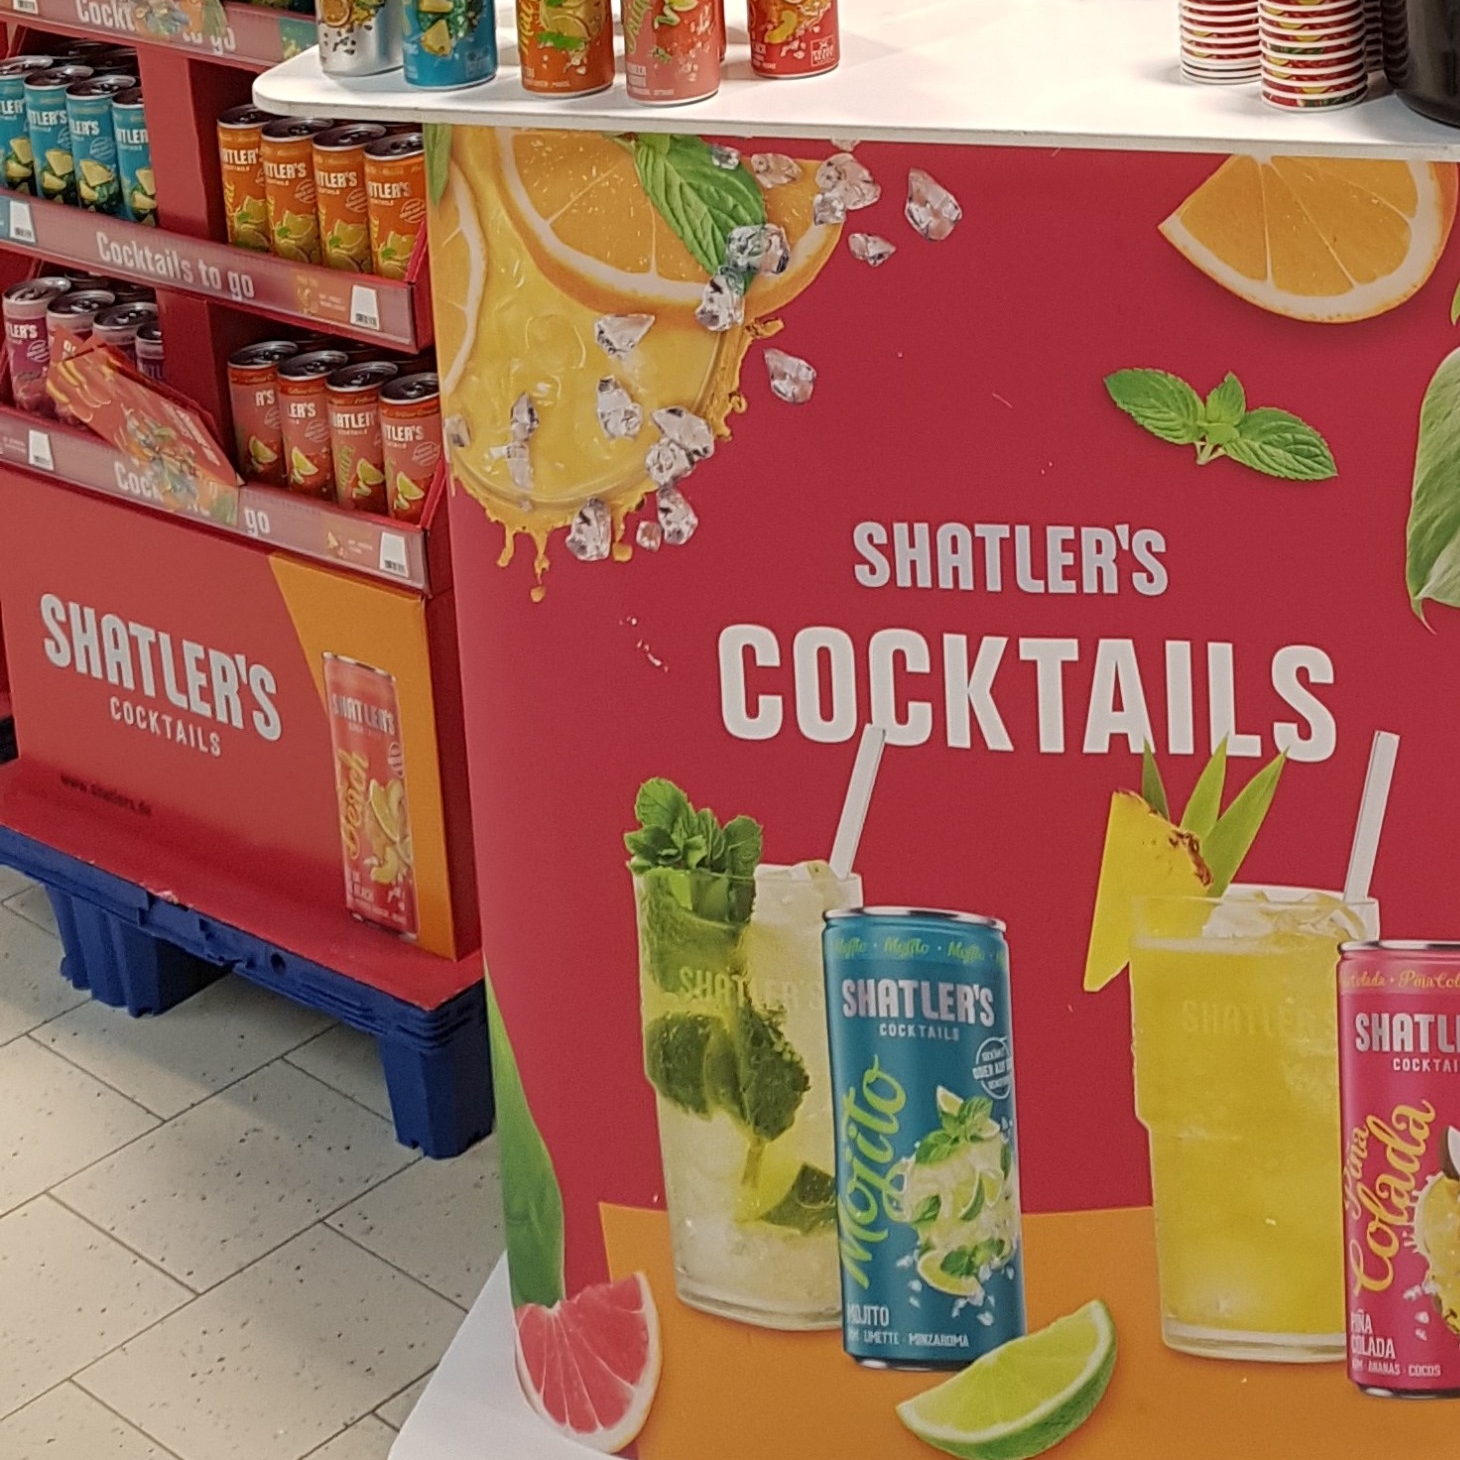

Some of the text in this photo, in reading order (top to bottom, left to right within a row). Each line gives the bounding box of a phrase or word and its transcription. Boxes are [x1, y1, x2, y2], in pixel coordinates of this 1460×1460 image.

[96, 231, 255, 301] Cocktails to go
[243, 507, 271, 537] go
[853, 521, 1168, 596] SHATLER'S
[40, 593, 282, 741] SHATLER'S
[718, 624, 1338, 764] COCKTAILS
[110, 696, 221, 758] COCKTAILS
[841, 977, 995, 1028] SHATLER'S
[879, 1023, 960, 1041] COCKTAILS
[836, 1053, 914, 1289] Mojito
[1349, 1099, 1436, 1297] Colada
